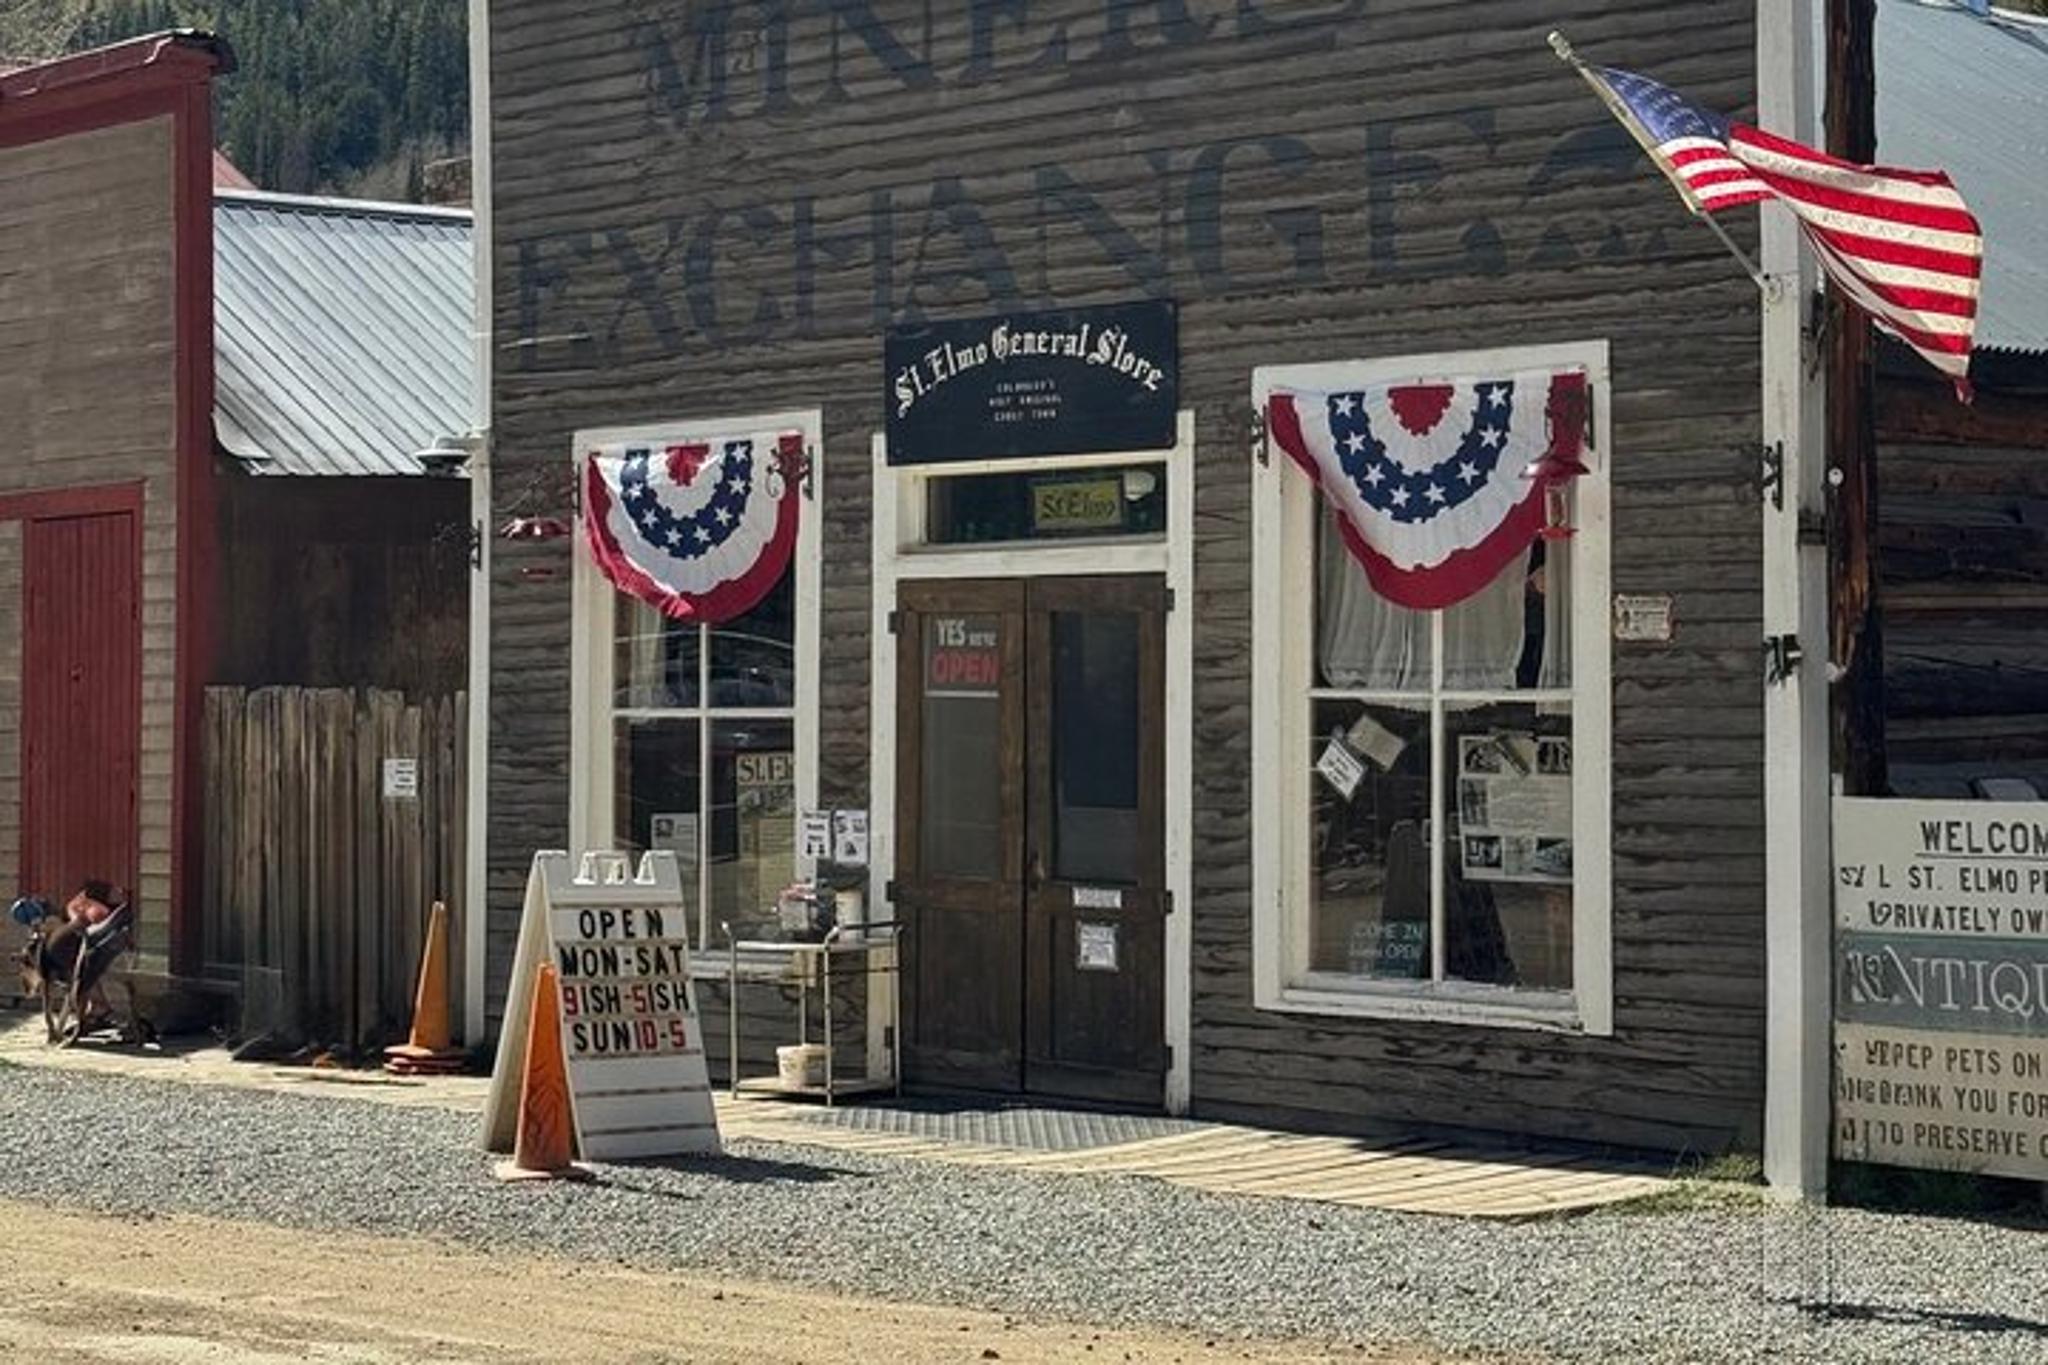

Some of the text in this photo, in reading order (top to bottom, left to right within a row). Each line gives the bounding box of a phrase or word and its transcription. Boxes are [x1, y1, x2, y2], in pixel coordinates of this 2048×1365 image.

[925, 341, 989, 382] Elmo
[991, 320, 1090, 363] General
[1086, 325, 1166, 392] Store
[936, 618, 965, 646] YES
[932, 652, 1000, 683] OPEN
[1959, 867, 2019, 894] ELMO
[578, 909, 665, 938] OPEN
[1945, 1046, 2001, 1076] PETS
[2012, 1051, 2041, 1079] ON
[1953, 1086, 1998, 1114] YOU
[1913, 1122, 2029, 1158] PRESERVE
